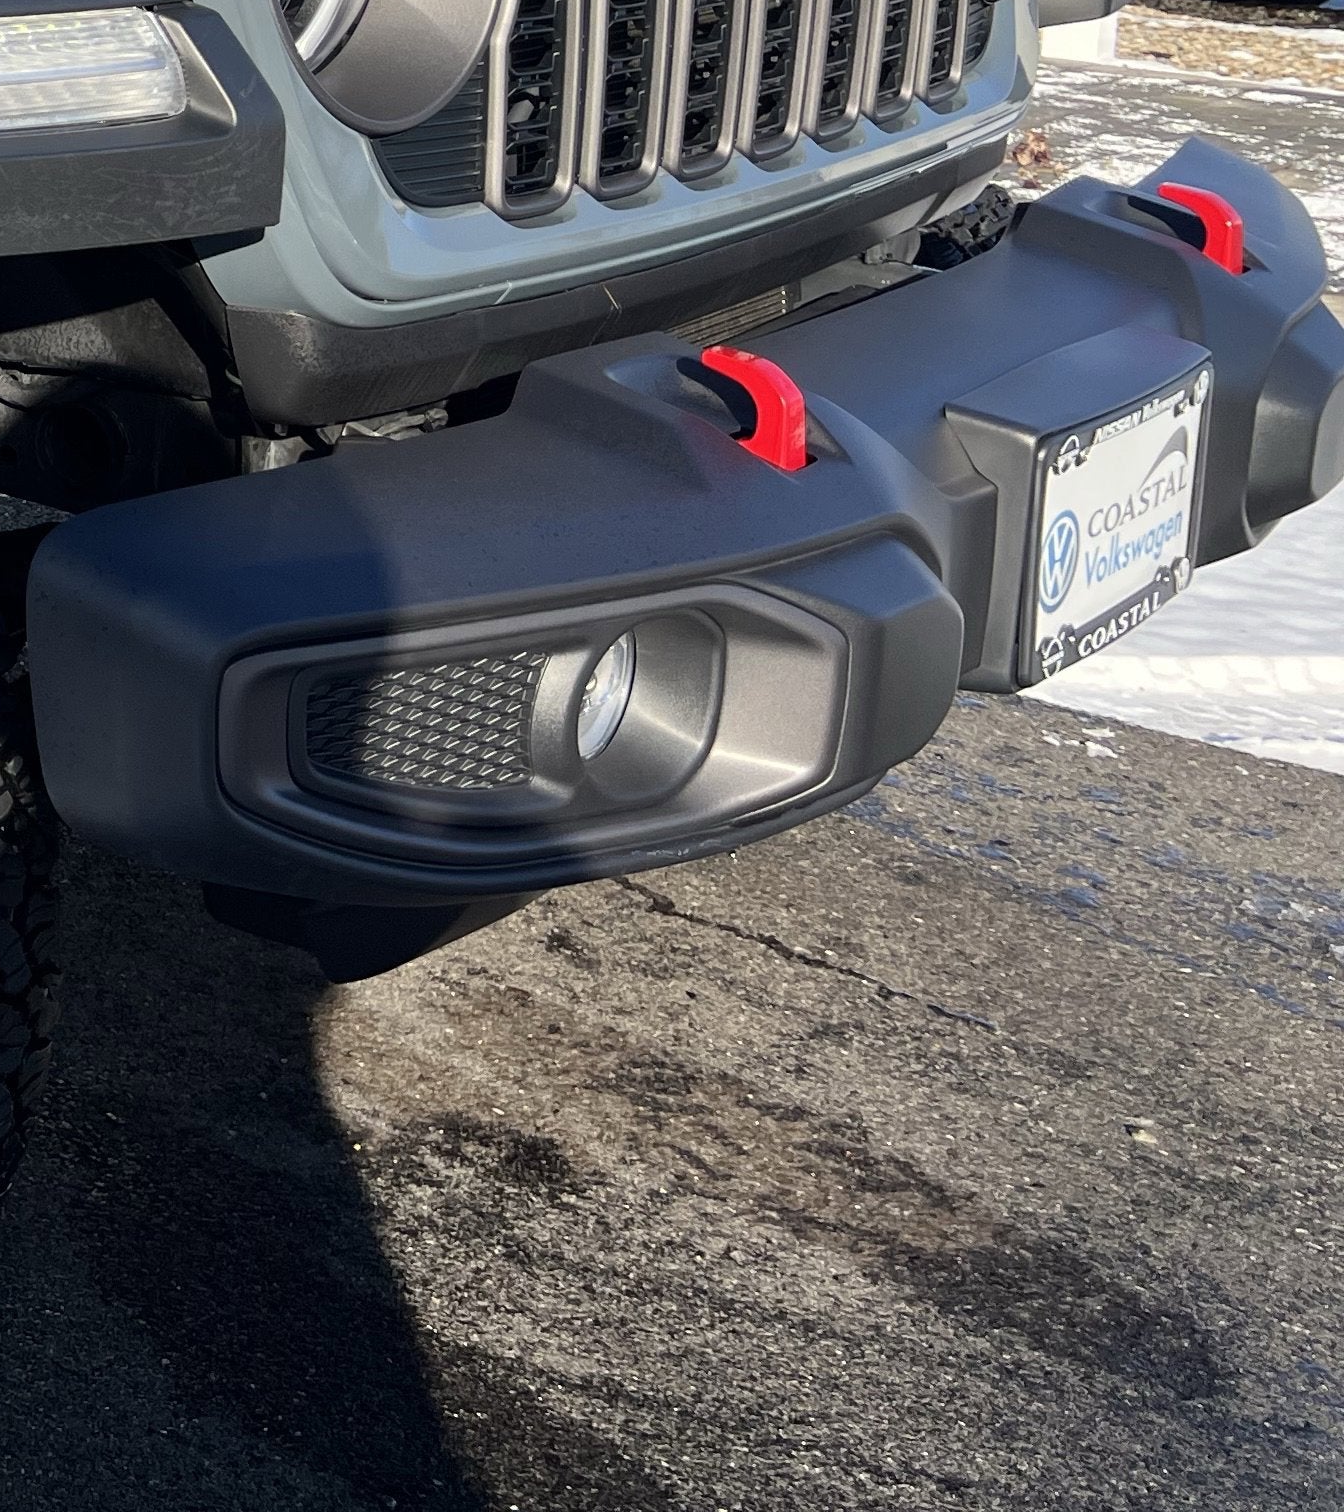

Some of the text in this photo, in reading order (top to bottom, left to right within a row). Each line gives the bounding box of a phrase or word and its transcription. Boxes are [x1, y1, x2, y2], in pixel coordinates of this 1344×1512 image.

[1087, 463, 1188, 539] COASTAL
[1083, 508, 1184, 590] Volkswagen
[1077, 590, 1163, 658] COASTAL
